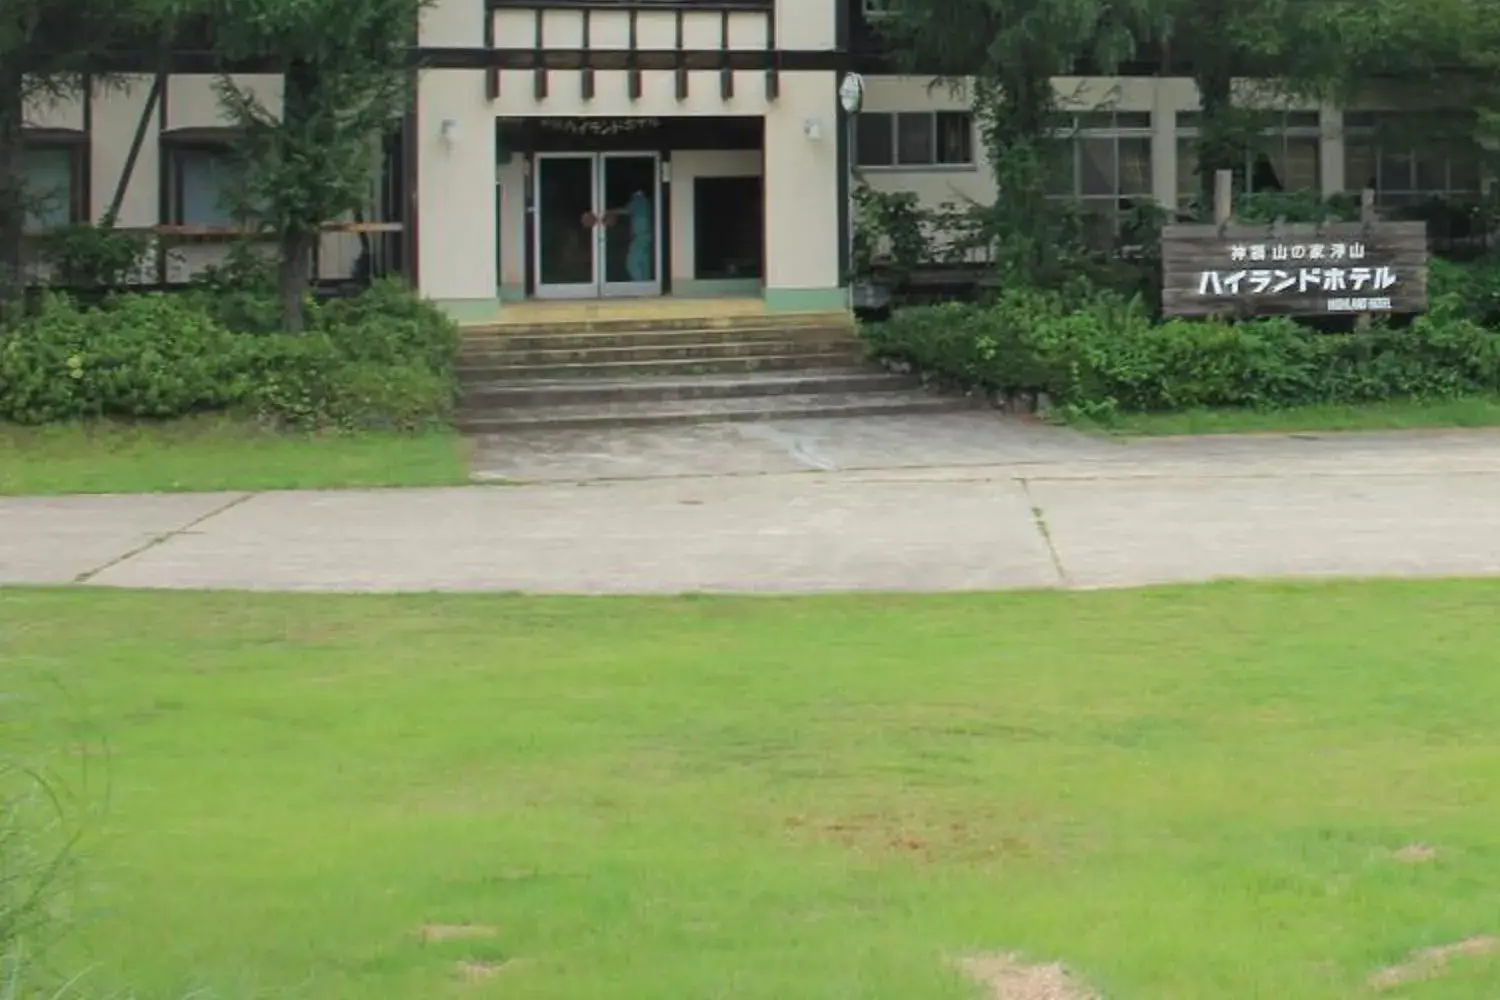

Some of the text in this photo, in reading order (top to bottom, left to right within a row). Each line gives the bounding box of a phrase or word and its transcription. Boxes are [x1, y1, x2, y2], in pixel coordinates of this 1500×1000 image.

[1199, 265, 1397, 295] ハイランドホテル
